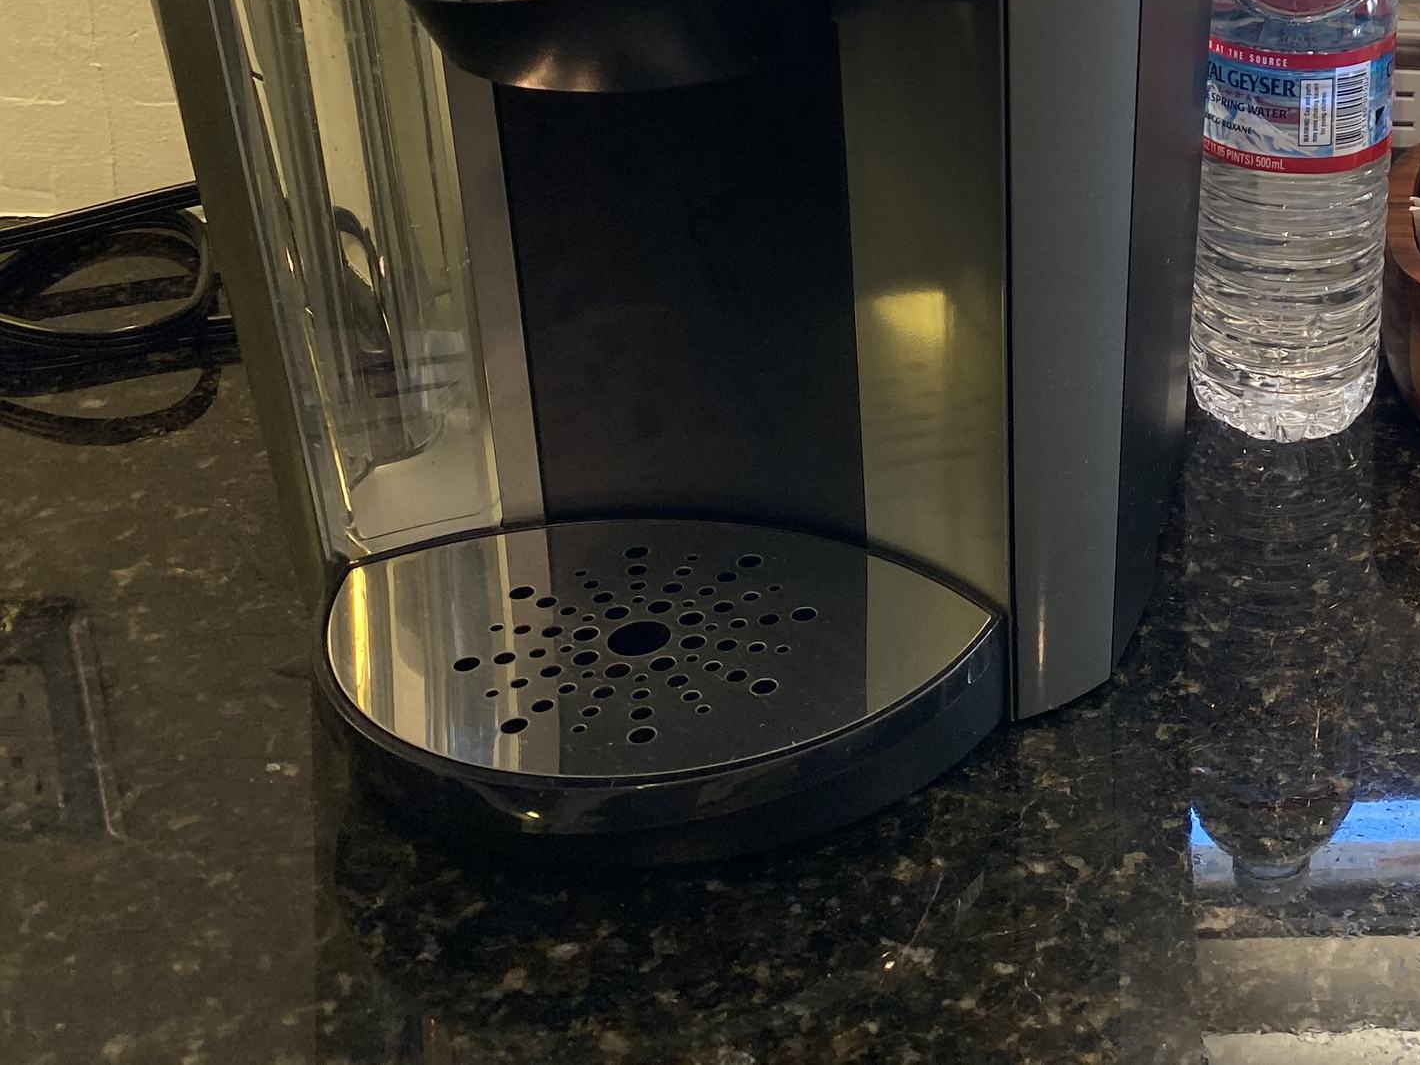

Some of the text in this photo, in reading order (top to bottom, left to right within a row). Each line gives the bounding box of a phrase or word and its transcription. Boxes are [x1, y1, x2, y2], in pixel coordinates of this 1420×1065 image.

[1215, 43, 1224, 54] AT
[1229, 48, 1244, 60] THE
[1249, 53, 1288, 68] SOURCE
[1227, 70, 1296, 97] GEYSER
[1211, 92, 1245, 112] SPRING
[1247, 105, 1287, 119] WATER
[1222, 120, 1253, 135] ROXANE
[1226, 149, 1254, 164] PINTS)
[1255, 157, 1286, 170] 500mL
